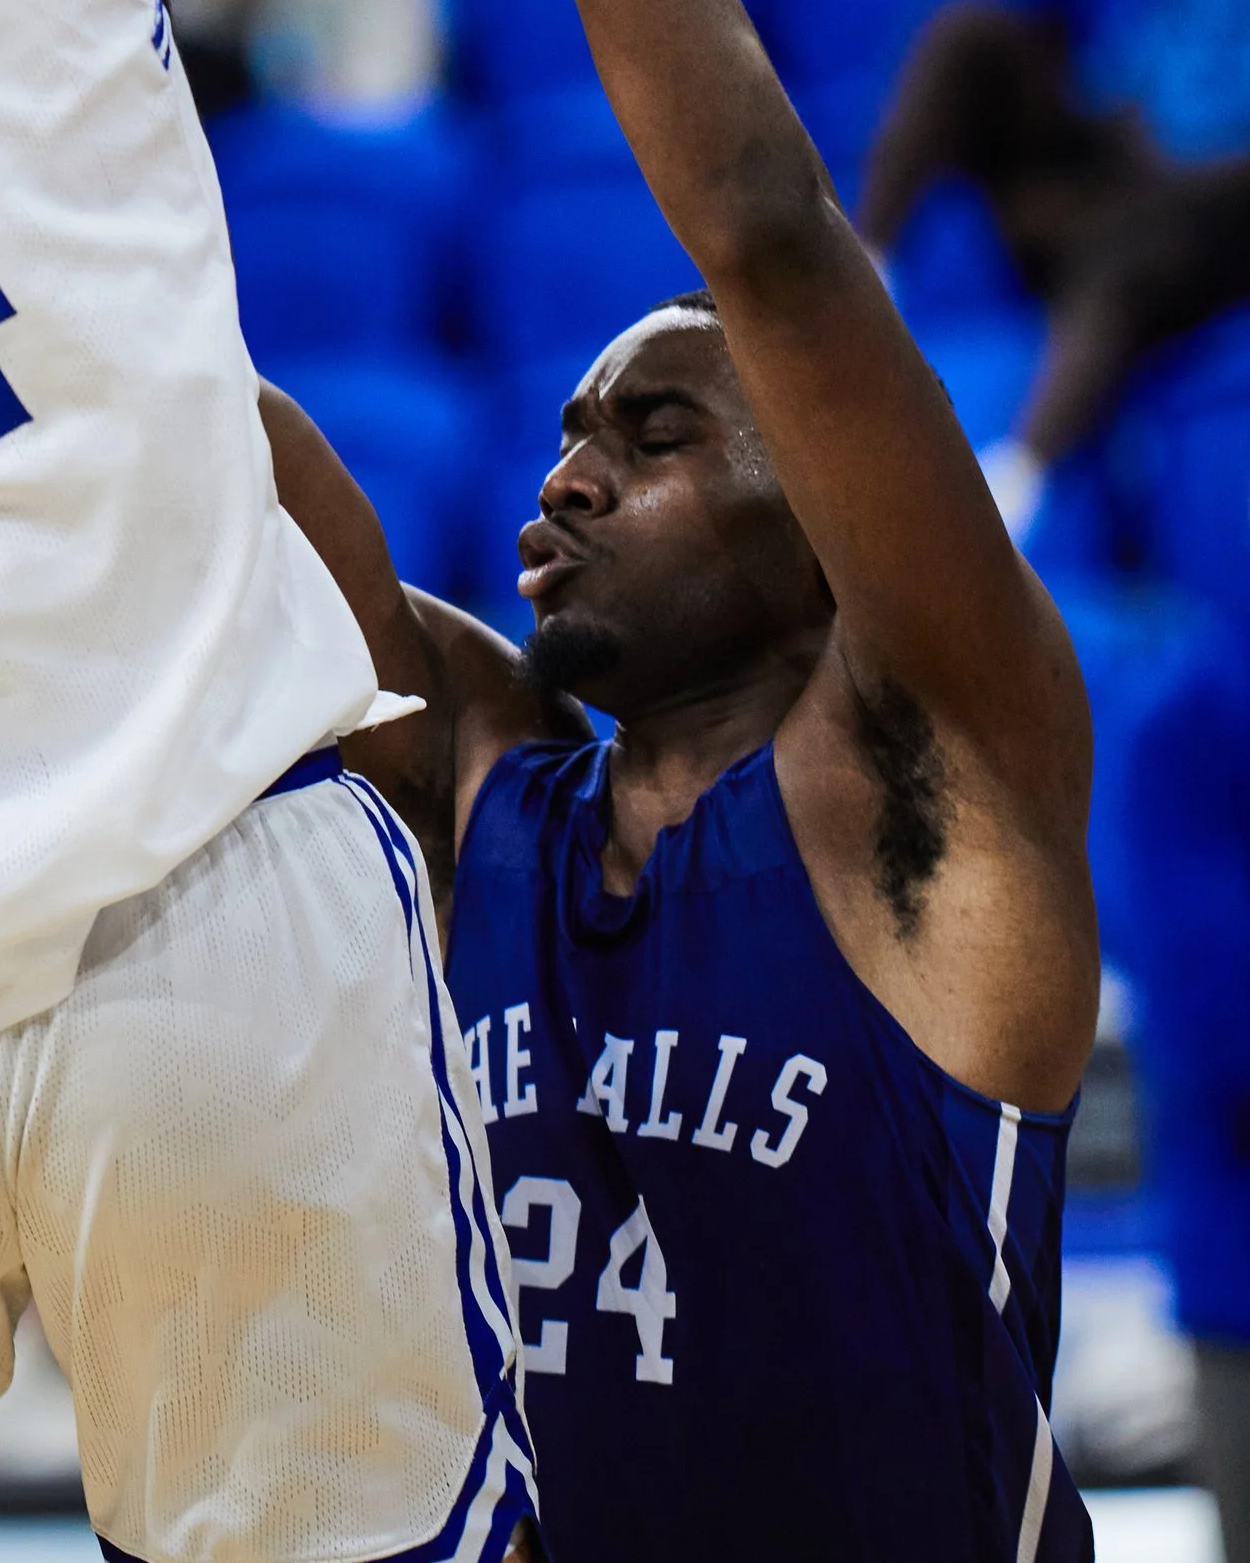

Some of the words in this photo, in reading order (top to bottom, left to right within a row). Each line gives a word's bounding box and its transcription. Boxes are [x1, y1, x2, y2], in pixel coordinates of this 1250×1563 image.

[464, 1001, 539, 1125] HE
[572, 1017, 828, 1168] ALLS
[502, 1175, 677, 1385] 24
